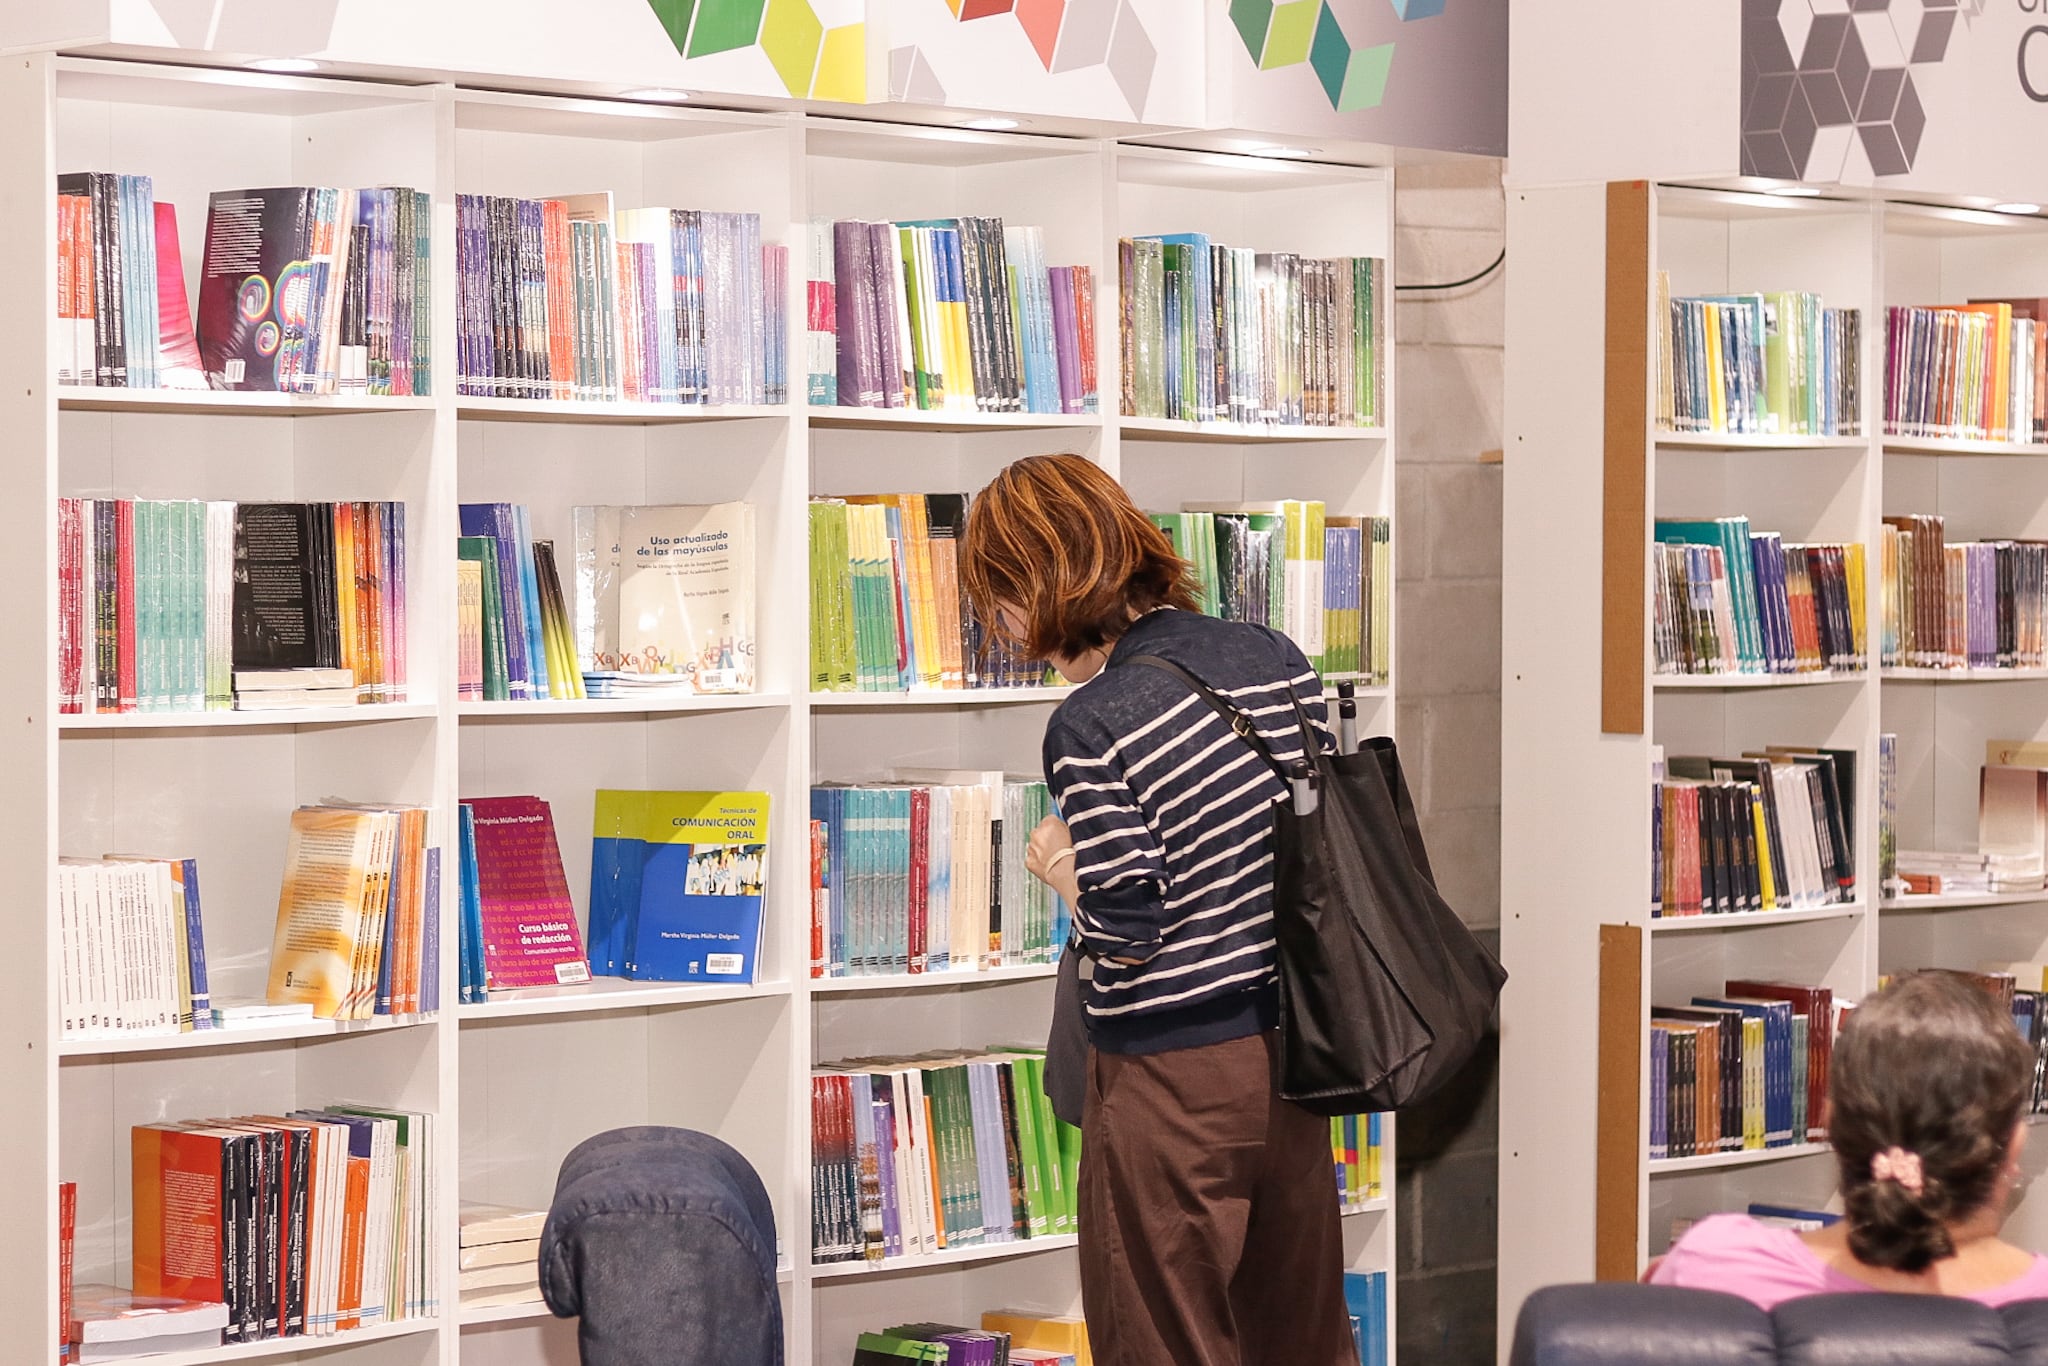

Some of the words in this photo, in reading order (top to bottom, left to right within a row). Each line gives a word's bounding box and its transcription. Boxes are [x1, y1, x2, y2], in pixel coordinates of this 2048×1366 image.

[650, 536, 670, 545] Uso
[673, 530, 728, 544] actualizado
[637, 546, 650, 556] de
[654, 547, 669, 556] las
[673, 542, 728, 556] mayúsculas
[519, 814, 544, 823] Delgado
[672, 817, 756, 827] COMUNICACIÓN
[727, 830, 754, 839] ORAL
[518, 924, 541, 933] Curso
[541, 922, 568, 932] básico
[521, 935, 531, 945] de
[532, 933, 572, 944] redacción
